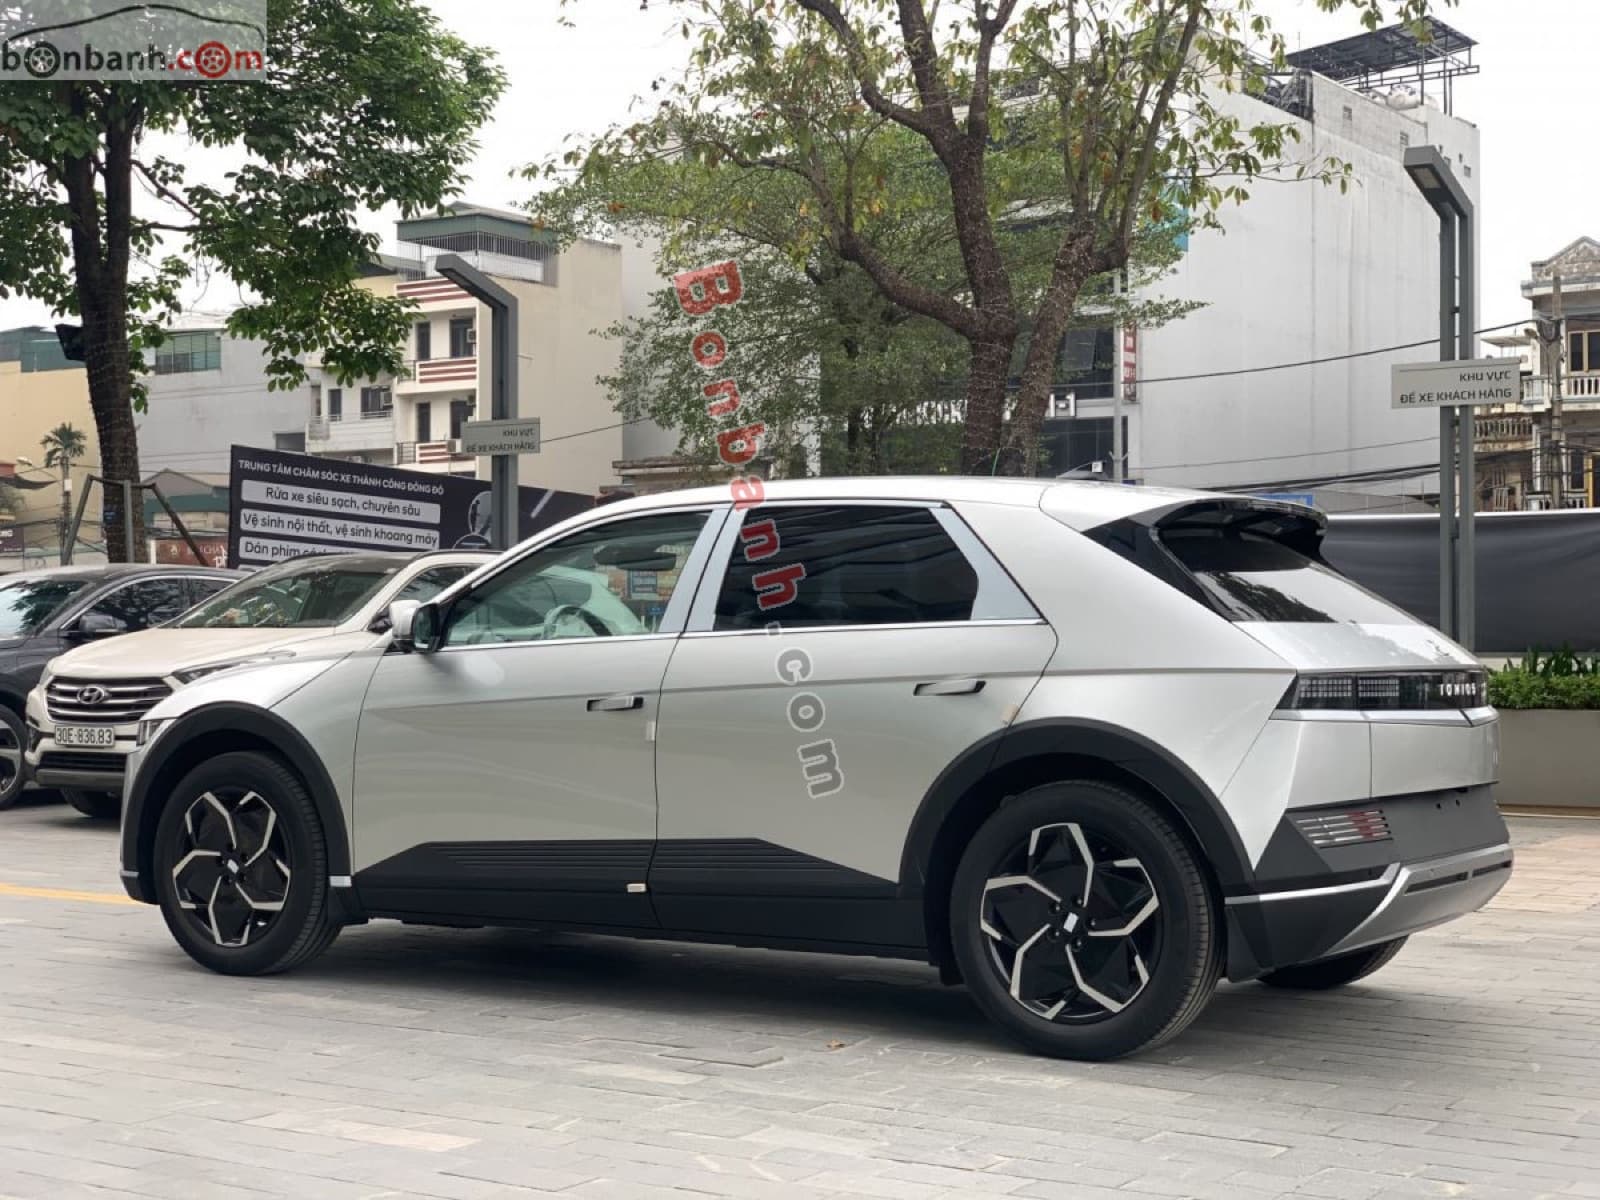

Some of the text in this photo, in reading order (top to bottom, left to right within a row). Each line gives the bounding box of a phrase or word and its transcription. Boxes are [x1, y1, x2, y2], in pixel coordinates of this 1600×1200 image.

[1460, 370, 1512, 382] KHU VỰC
[1419, 391, 1434, 403] XE
[1437, 389, 1476, 402] KHÁCH
[1479, 387, 1512, 400] HÀNG
[238, 459, 271, 473] TRUNG
[272, 462, 291, 476] TÂM
[321, 469, 339, 482] SÓC
[340, 473, 352, 484] XE
[352, 474, 381, 489] THÀNH
[266, 486, 421, 517] Rửa xe siêu sạch, chuyên sâu
[243, 512, 438, 547] Vệ sinh nội thất, vệ sinh khoang máy
[245, 540, 269, 555] Dán
[271, 544, 300, 558] phim
[56, 727, 113, 745] 30E-836.83
